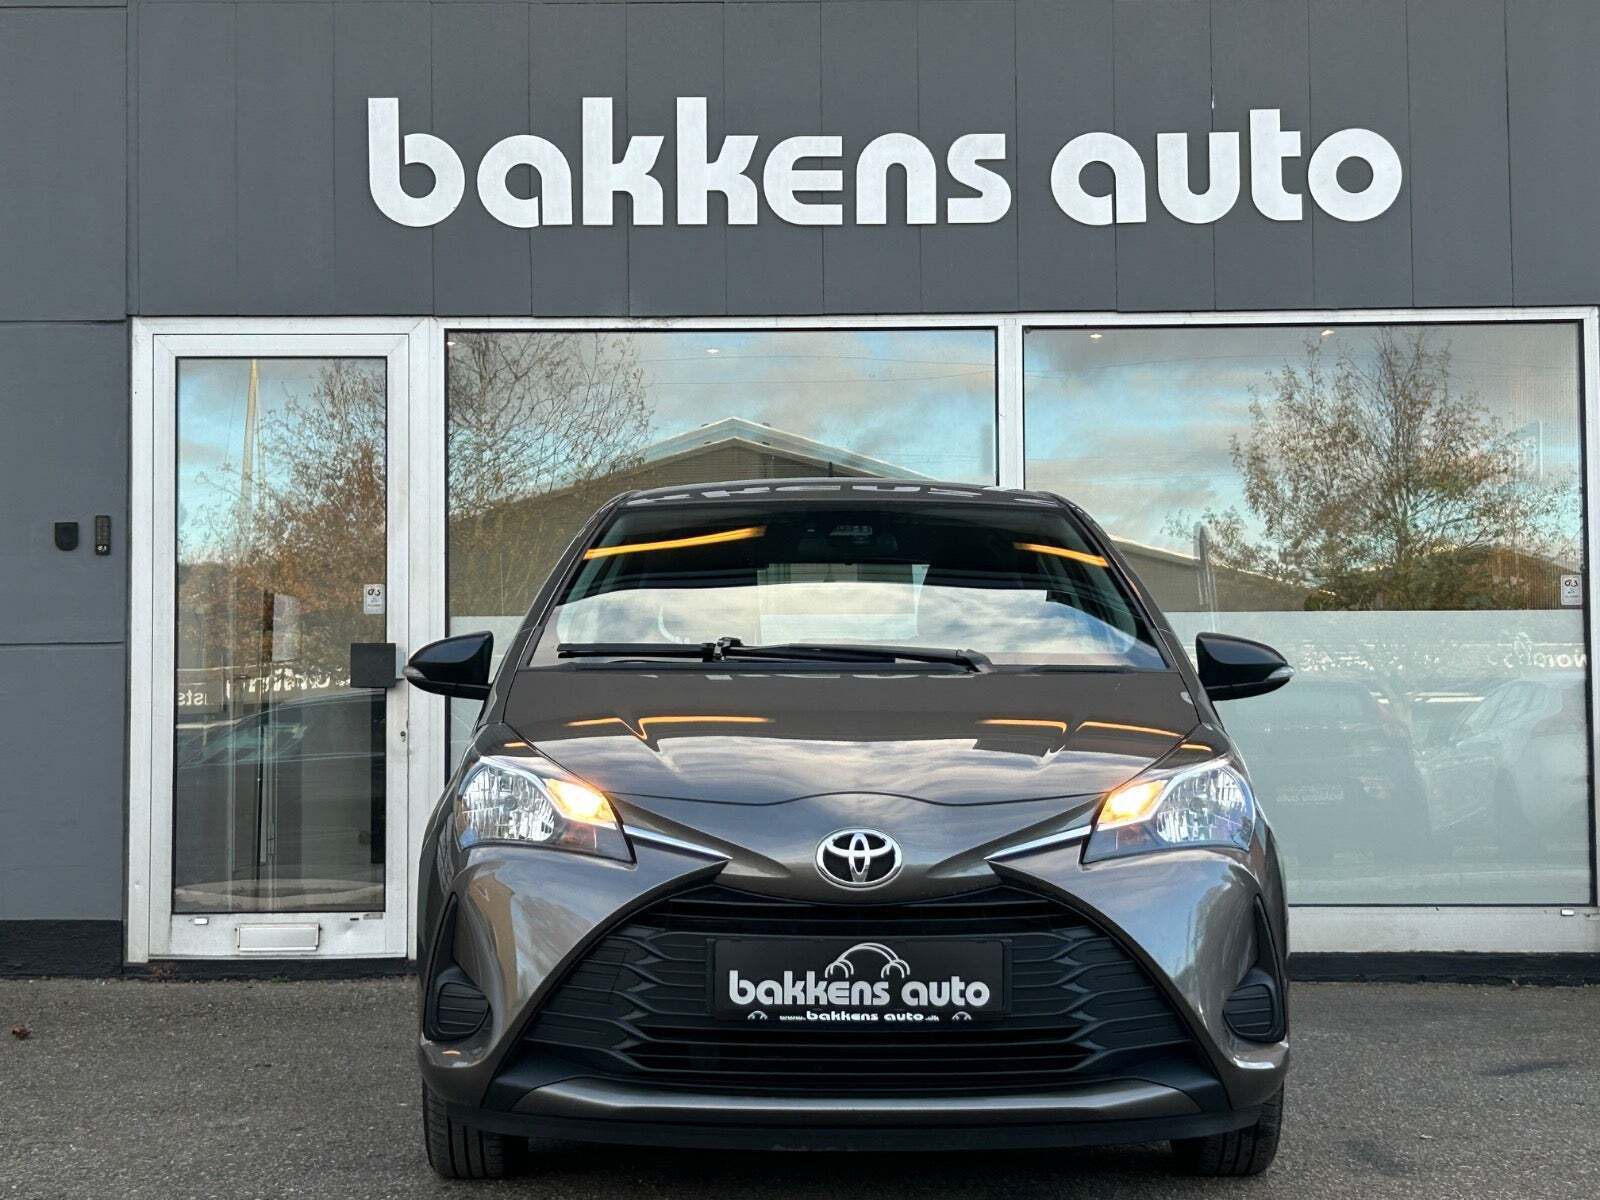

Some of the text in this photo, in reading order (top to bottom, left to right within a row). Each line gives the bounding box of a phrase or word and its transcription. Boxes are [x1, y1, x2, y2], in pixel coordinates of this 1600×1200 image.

[367, 96, 1403, 229] bakkens auto
[728, 969, 990, 1007] bakkens auto
